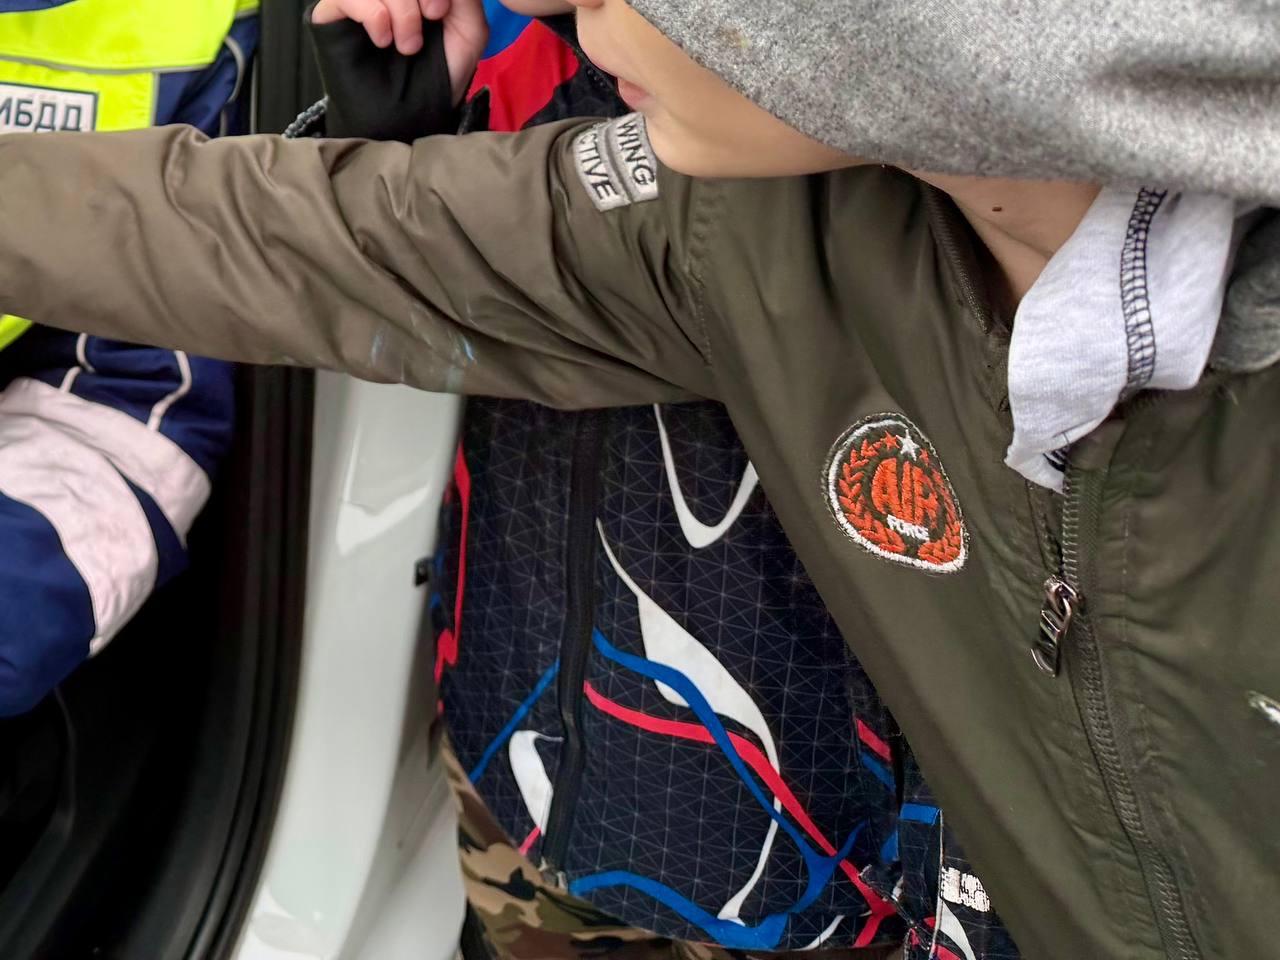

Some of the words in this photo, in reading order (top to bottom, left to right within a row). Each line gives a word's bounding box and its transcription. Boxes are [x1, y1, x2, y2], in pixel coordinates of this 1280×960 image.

[578, 132, 619, 200] CTIVE
[616, 120, 655, 185] WING
[871, 457, 939, 529] AIR
